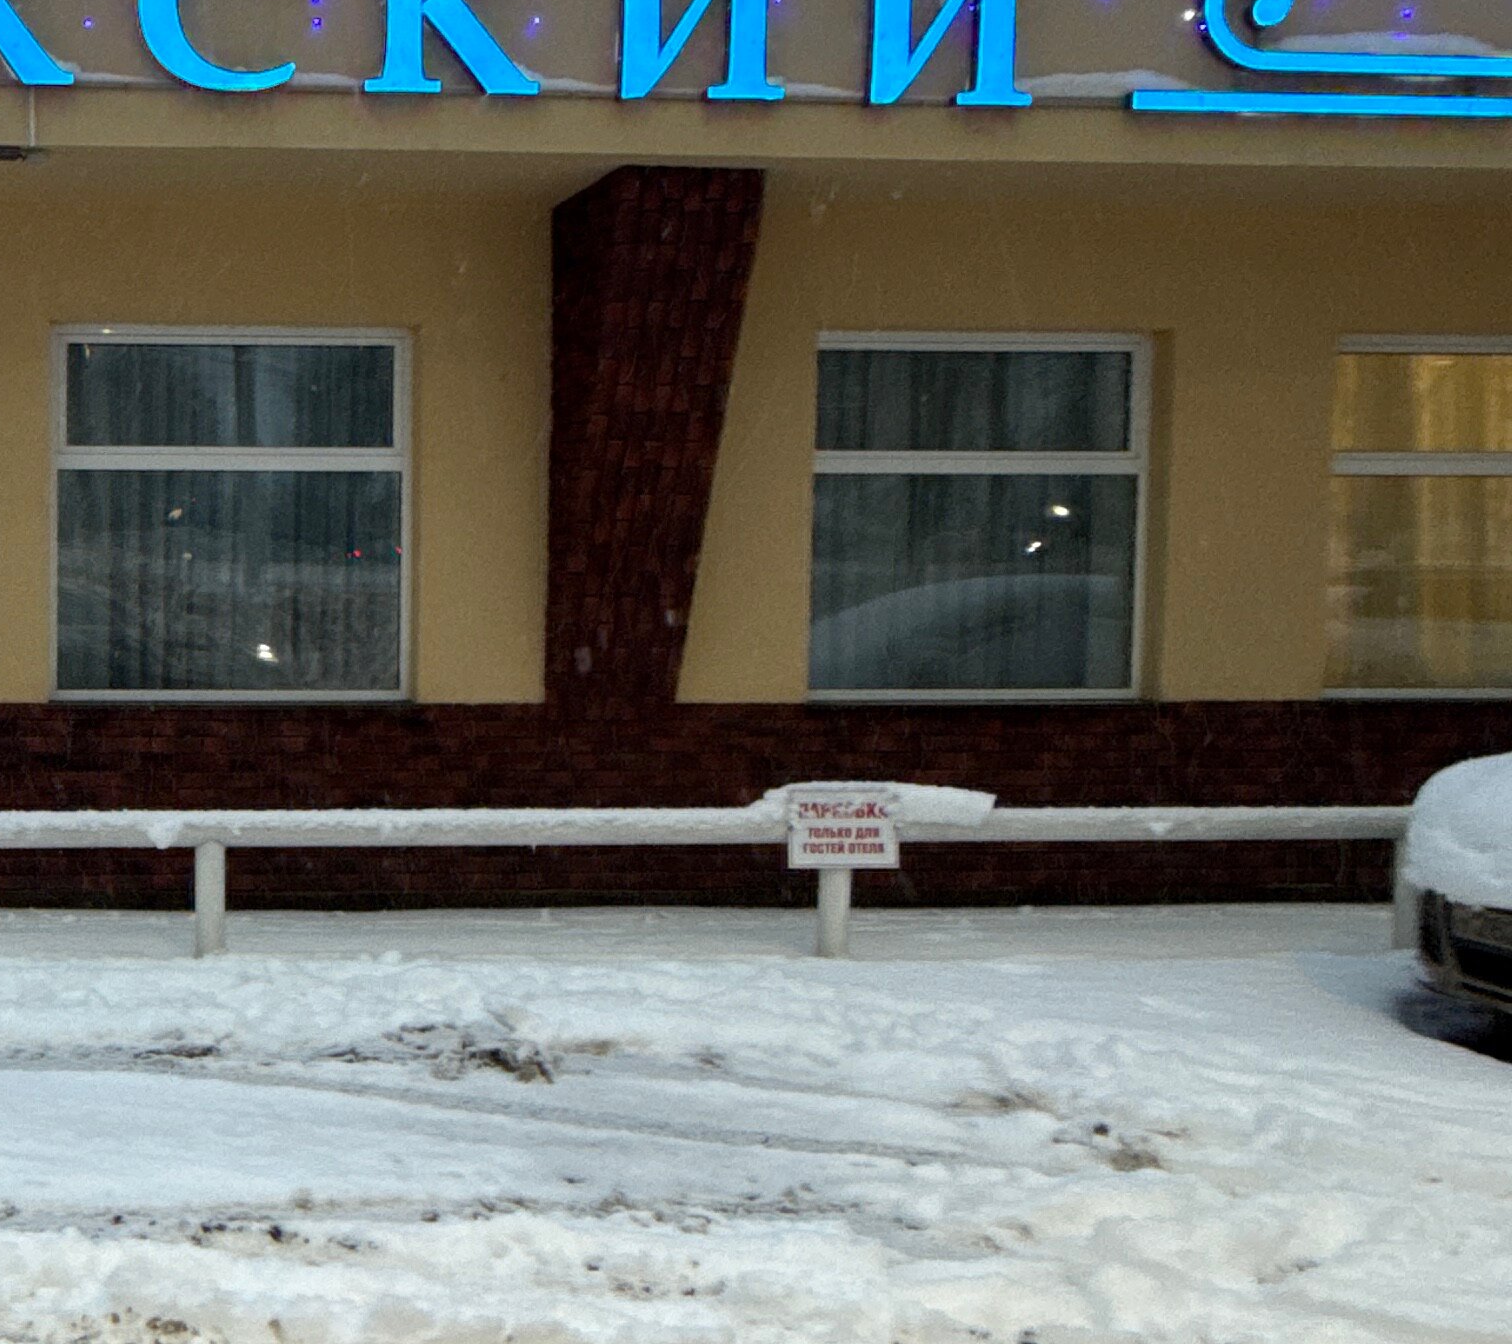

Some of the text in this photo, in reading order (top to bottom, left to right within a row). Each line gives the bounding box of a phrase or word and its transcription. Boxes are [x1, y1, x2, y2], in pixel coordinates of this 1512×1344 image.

[809, 827, 880, 841] ТОЛЬКО ДЛЯ
[803, 841, 885, 854] ГОСТЕЙ ОТЕЛЯ
